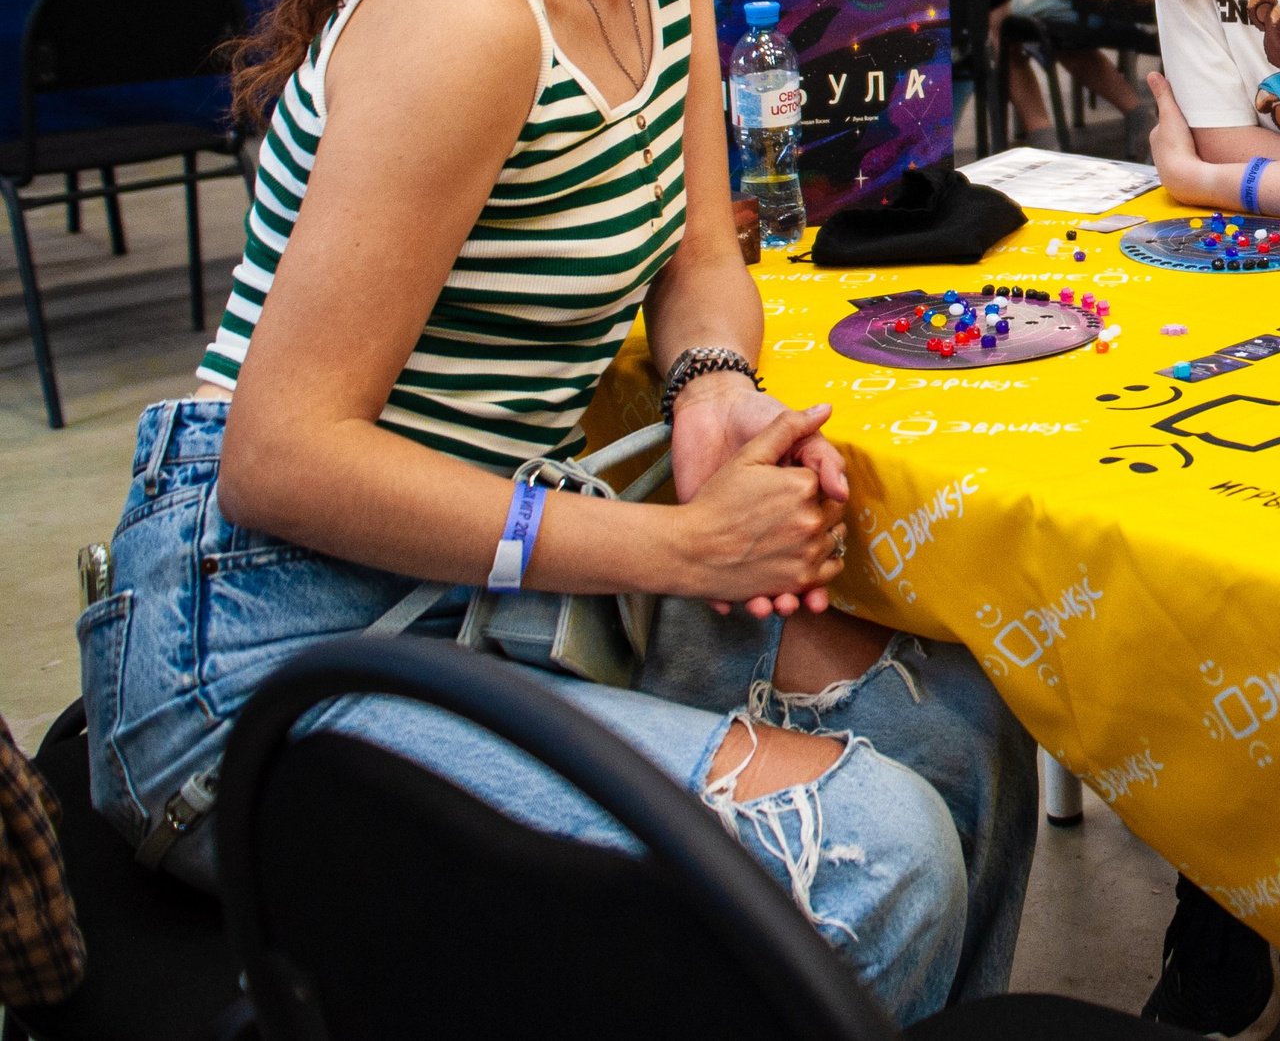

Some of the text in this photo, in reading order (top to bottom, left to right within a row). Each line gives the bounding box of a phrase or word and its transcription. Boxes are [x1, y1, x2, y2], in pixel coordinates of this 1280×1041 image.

[897, 377, 1032, 391] Эврикус
[940, 420, 1084, 436] Эврикус
[893, 472, 980, 561] Эврикус
